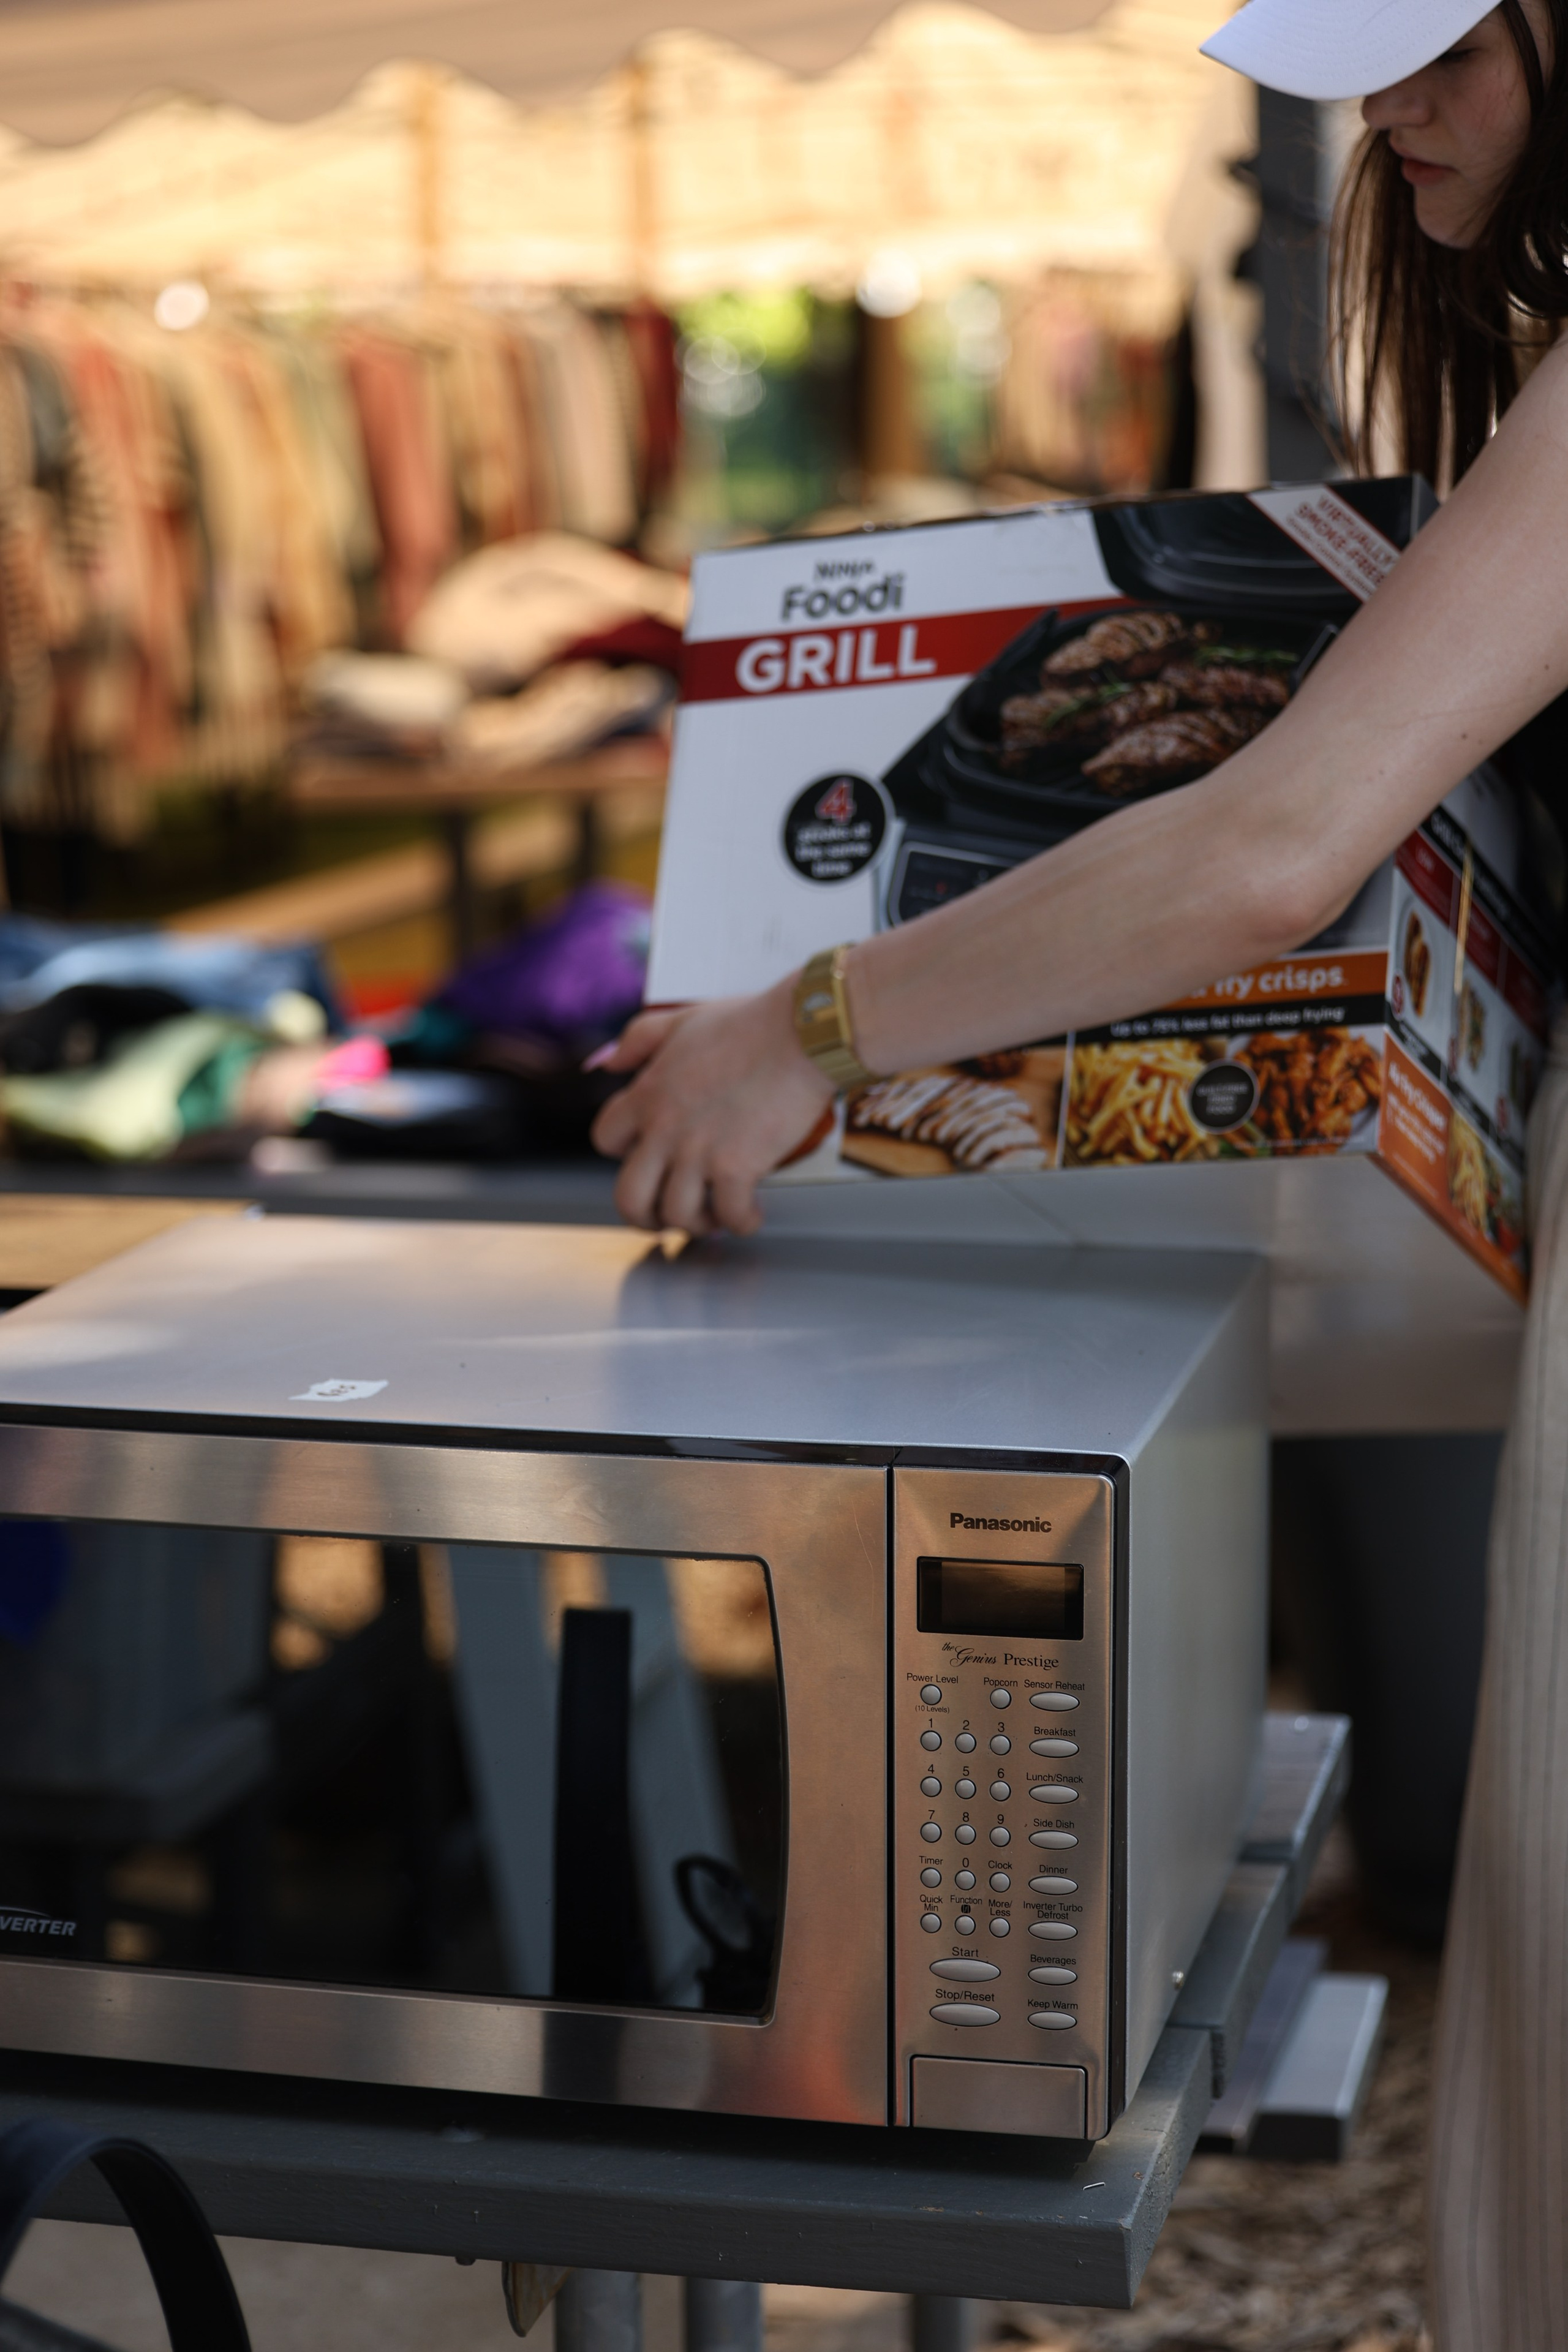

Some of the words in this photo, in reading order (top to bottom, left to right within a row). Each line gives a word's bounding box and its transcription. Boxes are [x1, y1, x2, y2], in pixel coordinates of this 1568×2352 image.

[780, 571, 905, 621] Foodi
[736, 624, 937, 695] GRILL
[816, 780, 857, 824] 4
[1258, 966, 1344, 993] crisps
[950, 1512, 1052, 1533] Panasonic
[941, 1642, 955, 1652] the
[949, 1645, 997, 1667] Genius
[1004, 1653, 1059, 1671] Prestige
[907, 1673, 933, 1683] Power
[936, 1675, 959, 1684] Level
[983, 1676, 1018, 1688] Popcorn
[1023, 1679, 1054, 1689] Sensor
[1055, 1681, 1085, 1691] Reheat
[926, 1705, 950, 1714] Levels)
[928, 1718, 933, 1728] 1
[962, 1720, 970, 1730] 2
[997, 1722, 1005, 1732] 3
[1034, 1726, 1076, 1737] Breakfast
[927, 1764, 935, 1774] 4
[962, 1766, 970, 1776] 5
[997, 1768, 1005, 1778] 6
[1026, 1772, 1084, 1784] Lunch/Snack
[928, 1809, 935, 1820] 7
[962, 1812, 970, 1822] 8
[997, 1814, 1005, 1824] 9
[1033, 1819, 1053, 1828] Side
[1055, 1820, 1075, 1828] Dish
[919, 1856, 943, 1866] Timer
[962, 1858, 969, 1868] 0
[988, 1860, 1012, 1869] Clock
[1039, 1864, 1068, 1874] Dinner
[919, 1894, 943, 1904] Quick
[950, 1895, 982, 1905] Function
[988, 1899, 1012, 1909] More/
[924, 1902, 938, 1912] Min
[1023, 1901, 1057, 1911] Inverter
[1058, 1902, 1083, 1912] Turbo
[990, 1907, 1011, 1917] Less
[1037, 1910, 1069, 1920] Defrost
[951, 1946, 979, 1958] Start
[1030, 1954, 1076, 1966] Beverages
[935, 1988, 995, 2002] Stop/Reset
[1027, 1999, 1050, 2009] Keep
[1052, 2000, 1078, 2010] Warm
